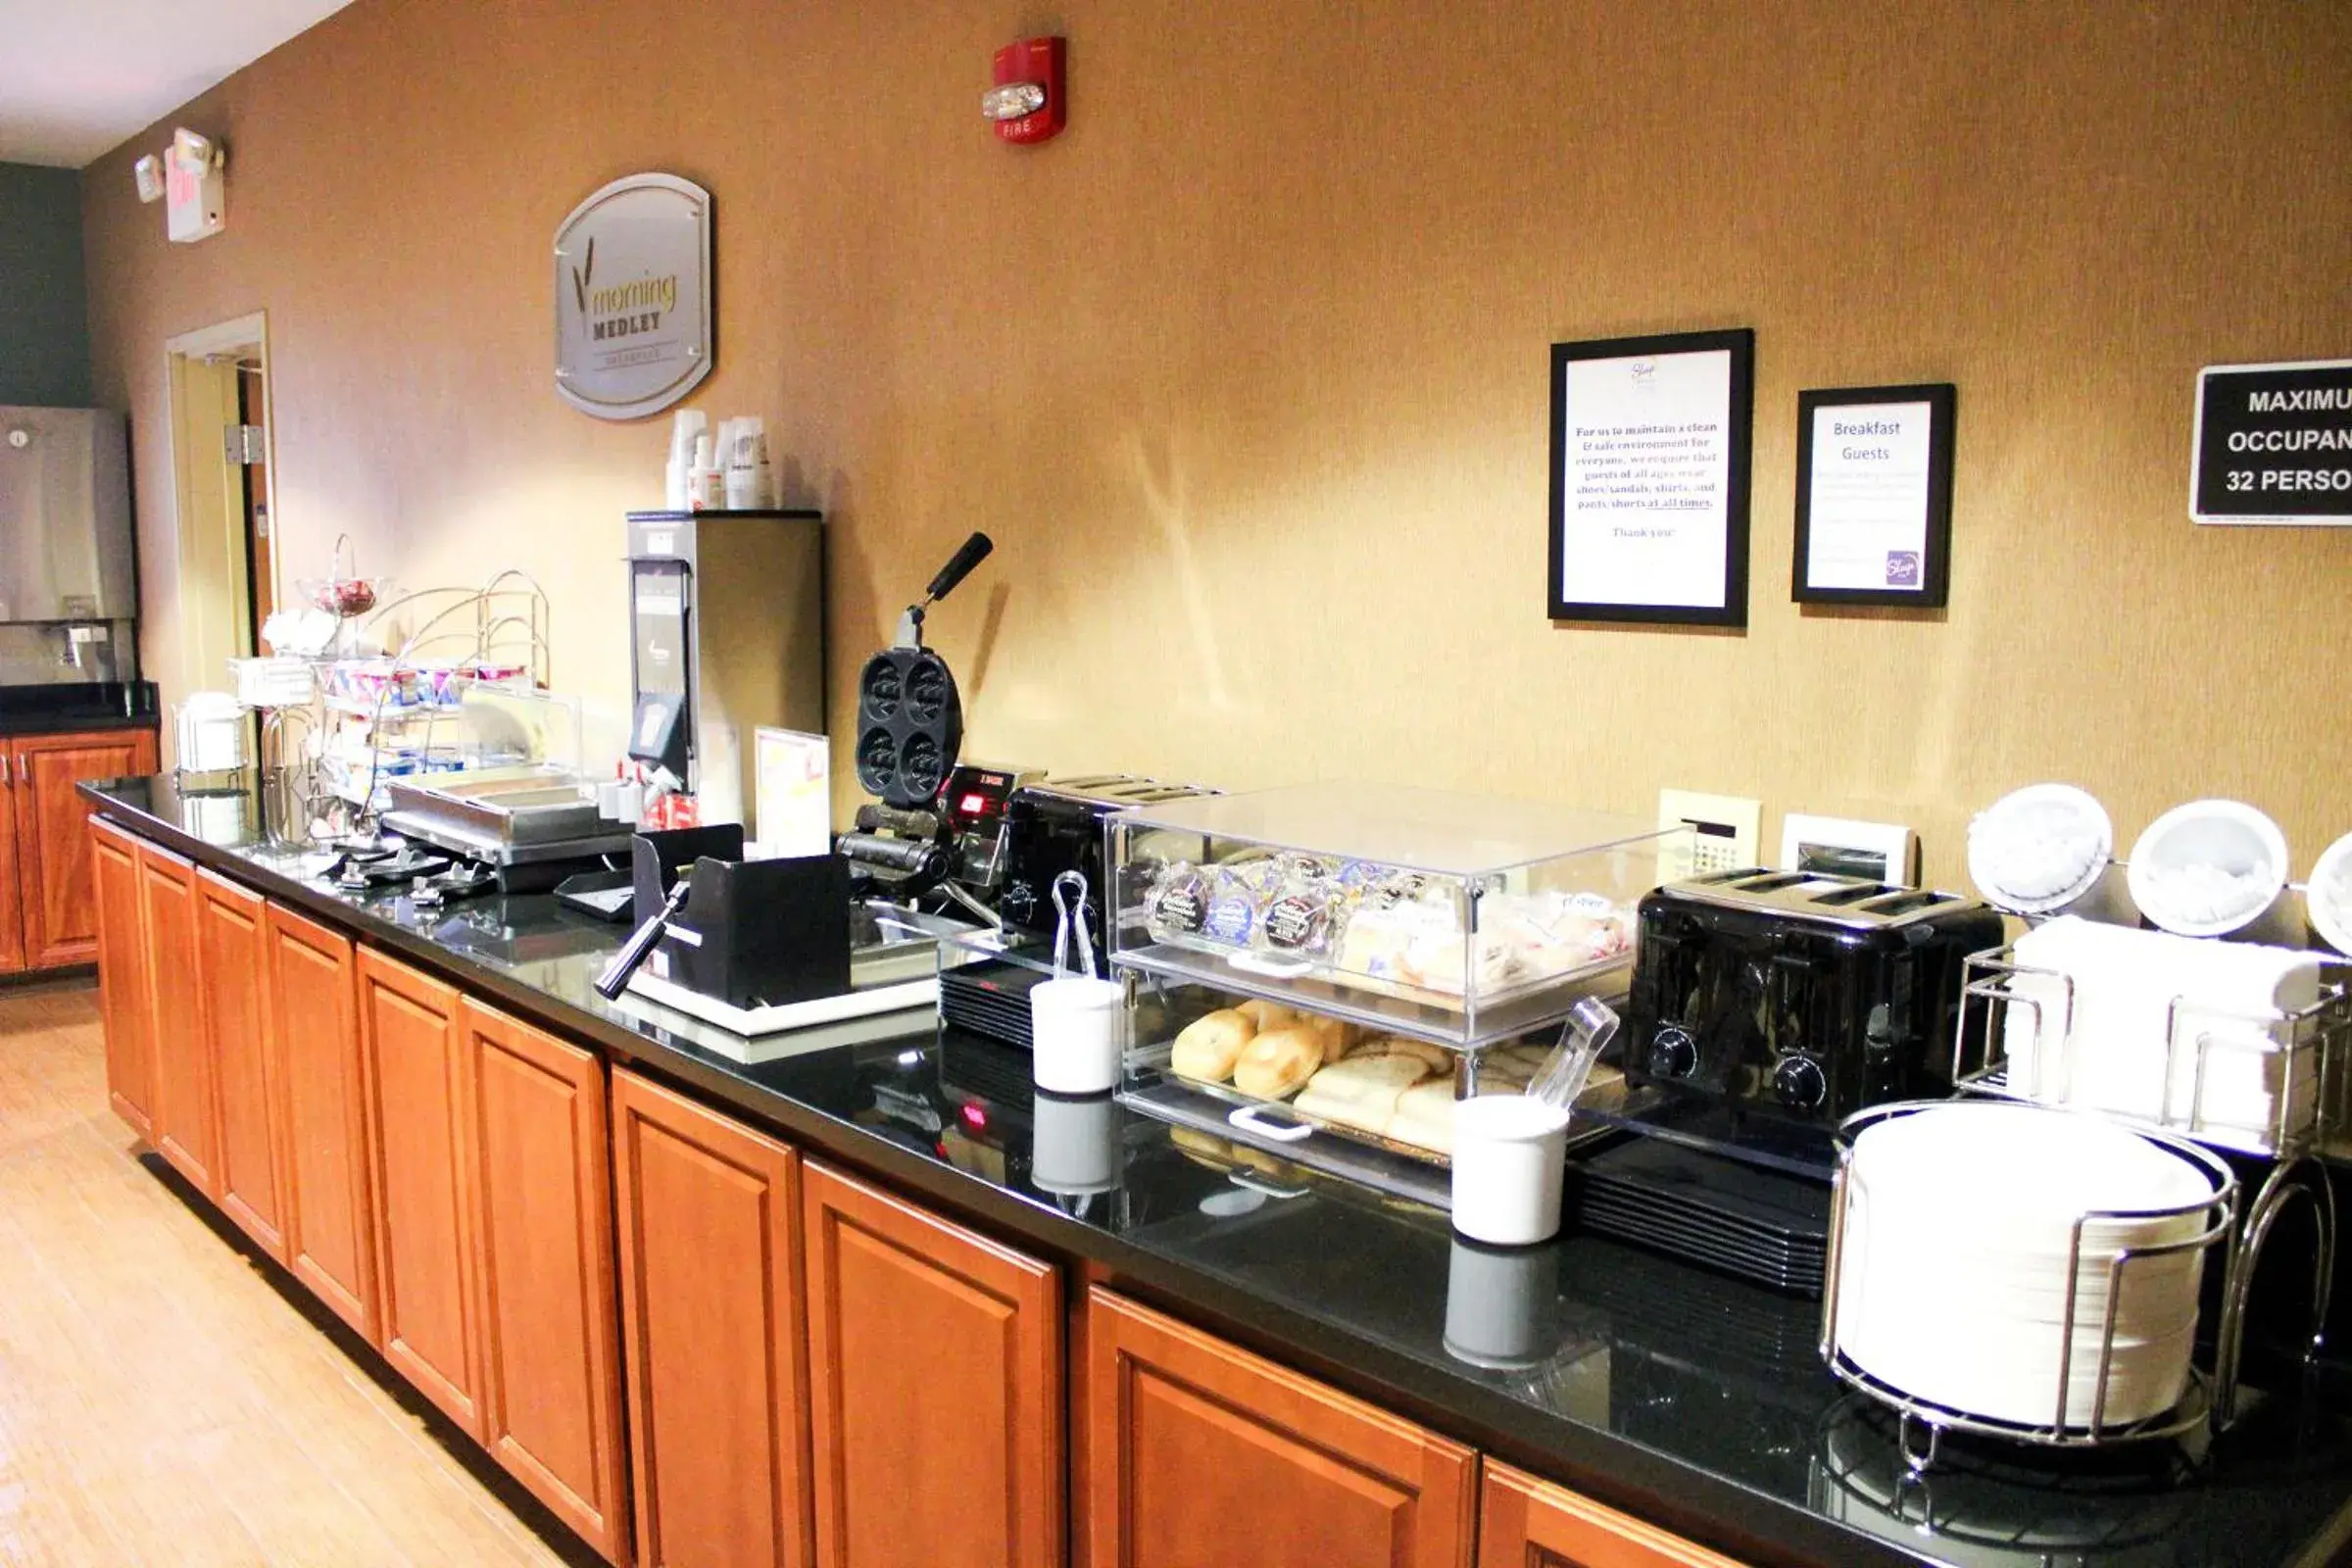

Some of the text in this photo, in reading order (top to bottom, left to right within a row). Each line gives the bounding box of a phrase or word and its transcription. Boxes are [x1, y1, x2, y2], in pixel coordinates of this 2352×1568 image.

[1004, 119, 1031, 137] FIRE
[593, 273, 676, 315] morning
[593, 312, 661, 341] MEDLEY
[2248, 388, 2352, 413] MAXIMU
[1576, 427, 1595, 437] For
[1612, 426, 1623, 436] to
[1625, 424, 1676, 436] maintain
[1687, 422, 1718, 433] clean
[1834, 421, 1900, 435] Breakfast
[1617, 438, 1688, 450] environment
[1690, 437, 1711, 448] for
[2227, 429, 2352, 452] OCCUPAN
[1692, 452, 1718, 463] that
[1841, 447, 1889, 461] Guests
[1585, 470, 1618, 482] guests
[1620, 469, 1632, 479] of
[1634, 468, 1647, 478] all
[2227, 469, 2352, 491] 32 PERSO
